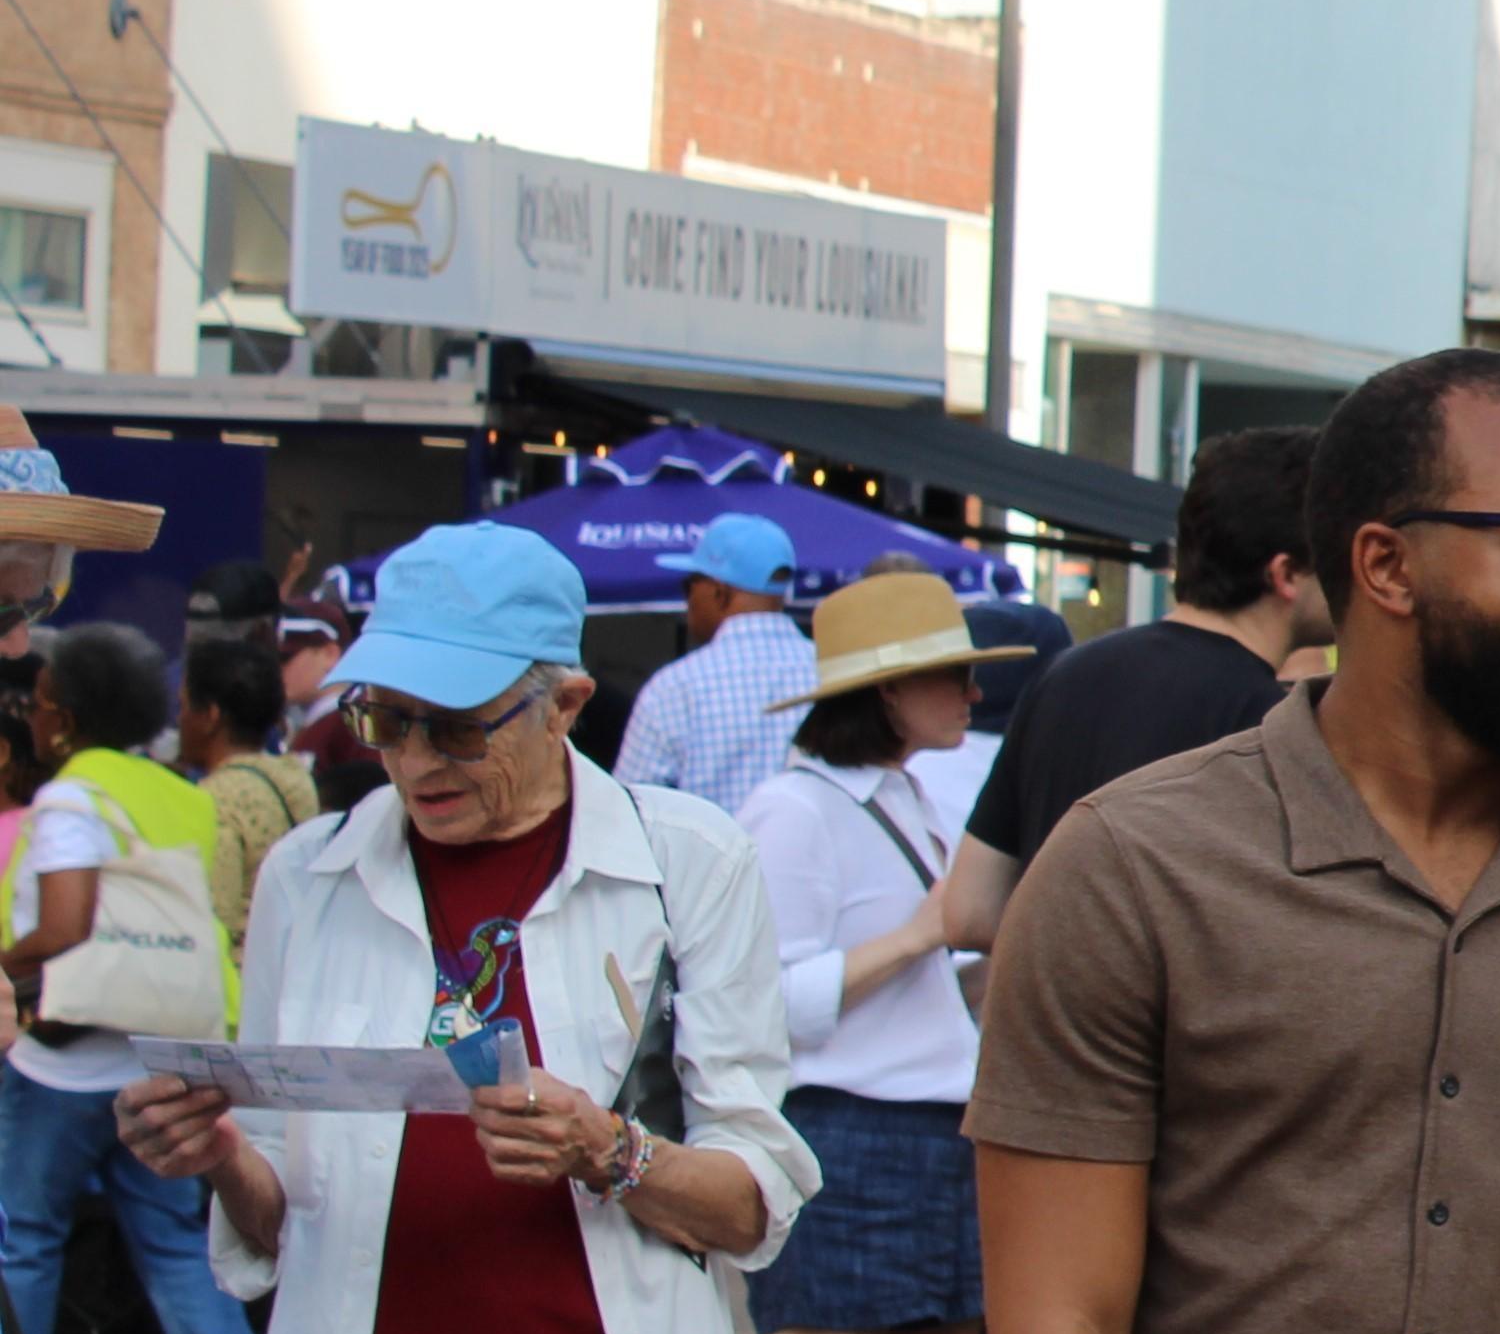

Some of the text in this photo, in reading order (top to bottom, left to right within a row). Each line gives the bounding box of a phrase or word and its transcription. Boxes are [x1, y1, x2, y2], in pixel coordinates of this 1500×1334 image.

[623, 208, 929, 327] COME FIND YOUR LOUISIANA!
[577, 520, 703, 549] LOUISIAN
